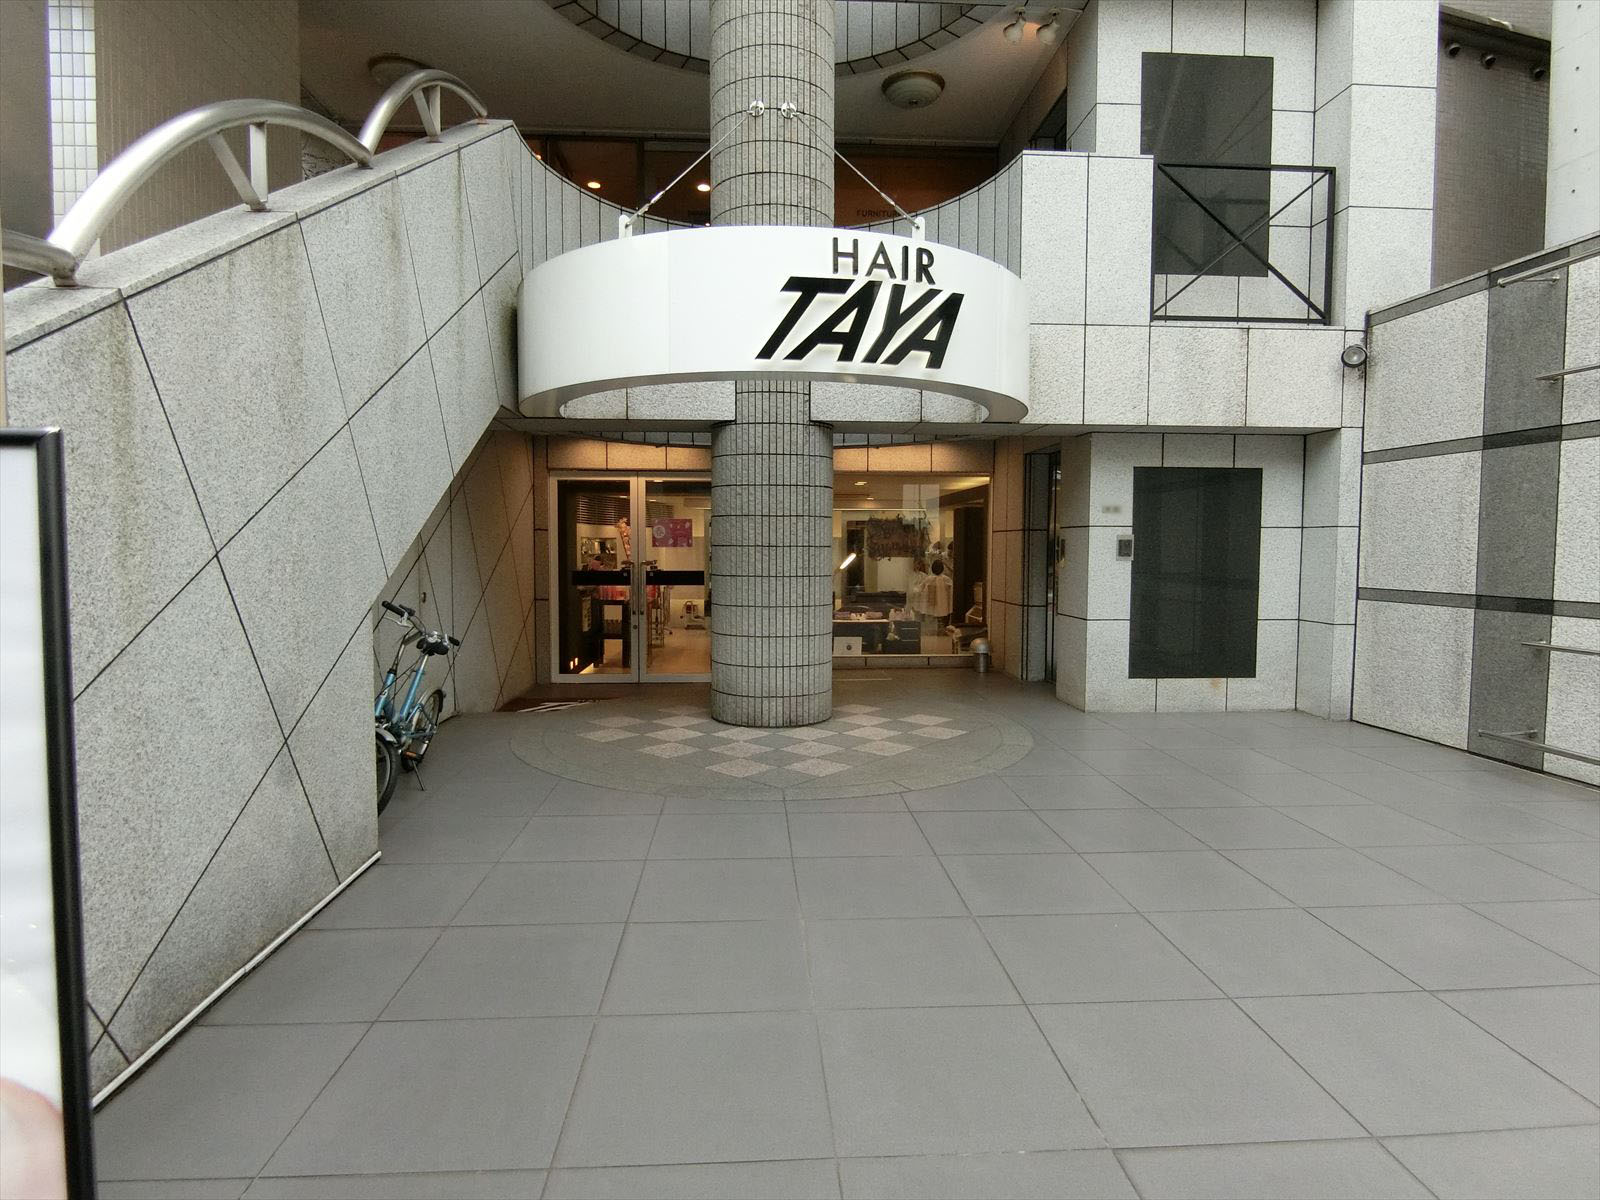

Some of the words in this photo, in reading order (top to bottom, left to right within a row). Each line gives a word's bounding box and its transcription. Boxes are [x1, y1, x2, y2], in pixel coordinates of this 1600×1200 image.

[856, 208, 902, 218] FURNITUR
[832, 237, 936, 285] HAIR
[755, 276, 965, 370] TAYA
